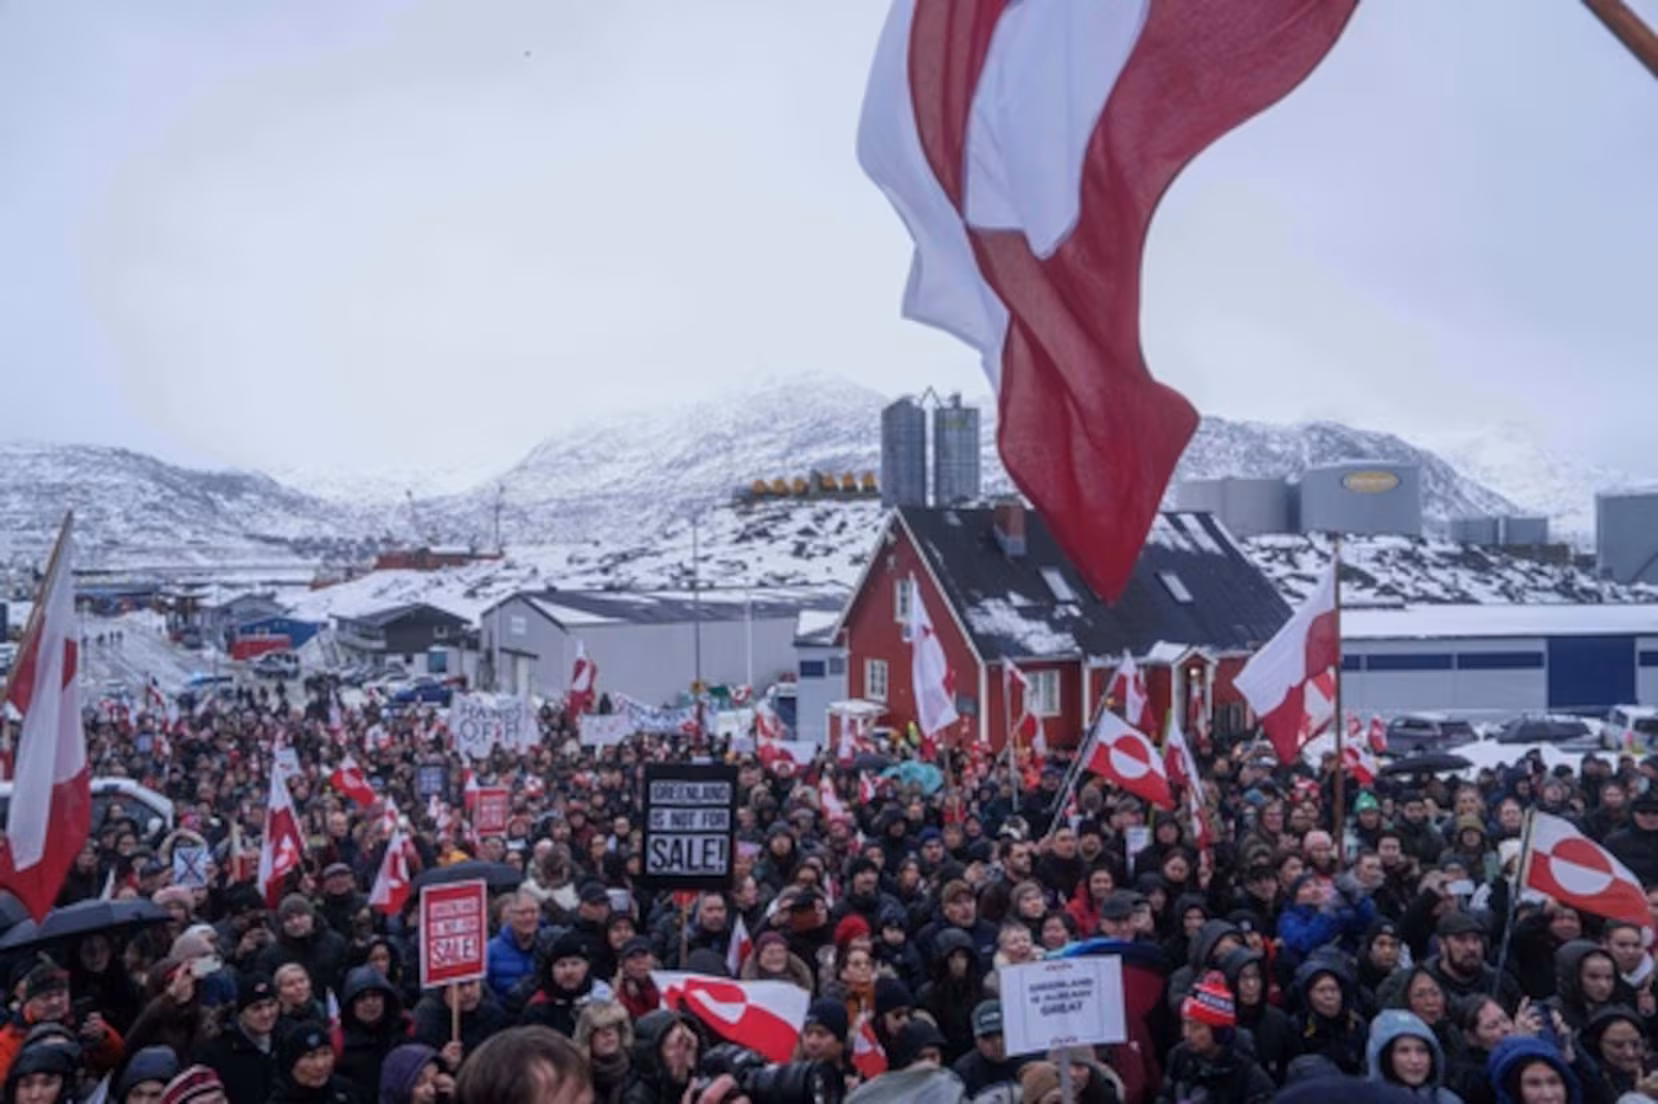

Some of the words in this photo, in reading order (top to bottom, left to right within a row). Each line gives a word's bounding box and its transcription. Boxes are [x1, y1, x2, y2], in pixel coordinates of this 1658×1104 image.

[653, 783, 728, 800] GREENLAND
[652, 811, 665, 827] IS
[670, 811, 696, 827] NOT
[702, 811, 727, 827] FOR
[650, 837, 725, 871] SALE!
[431, 936, 479, 965] SALE!
